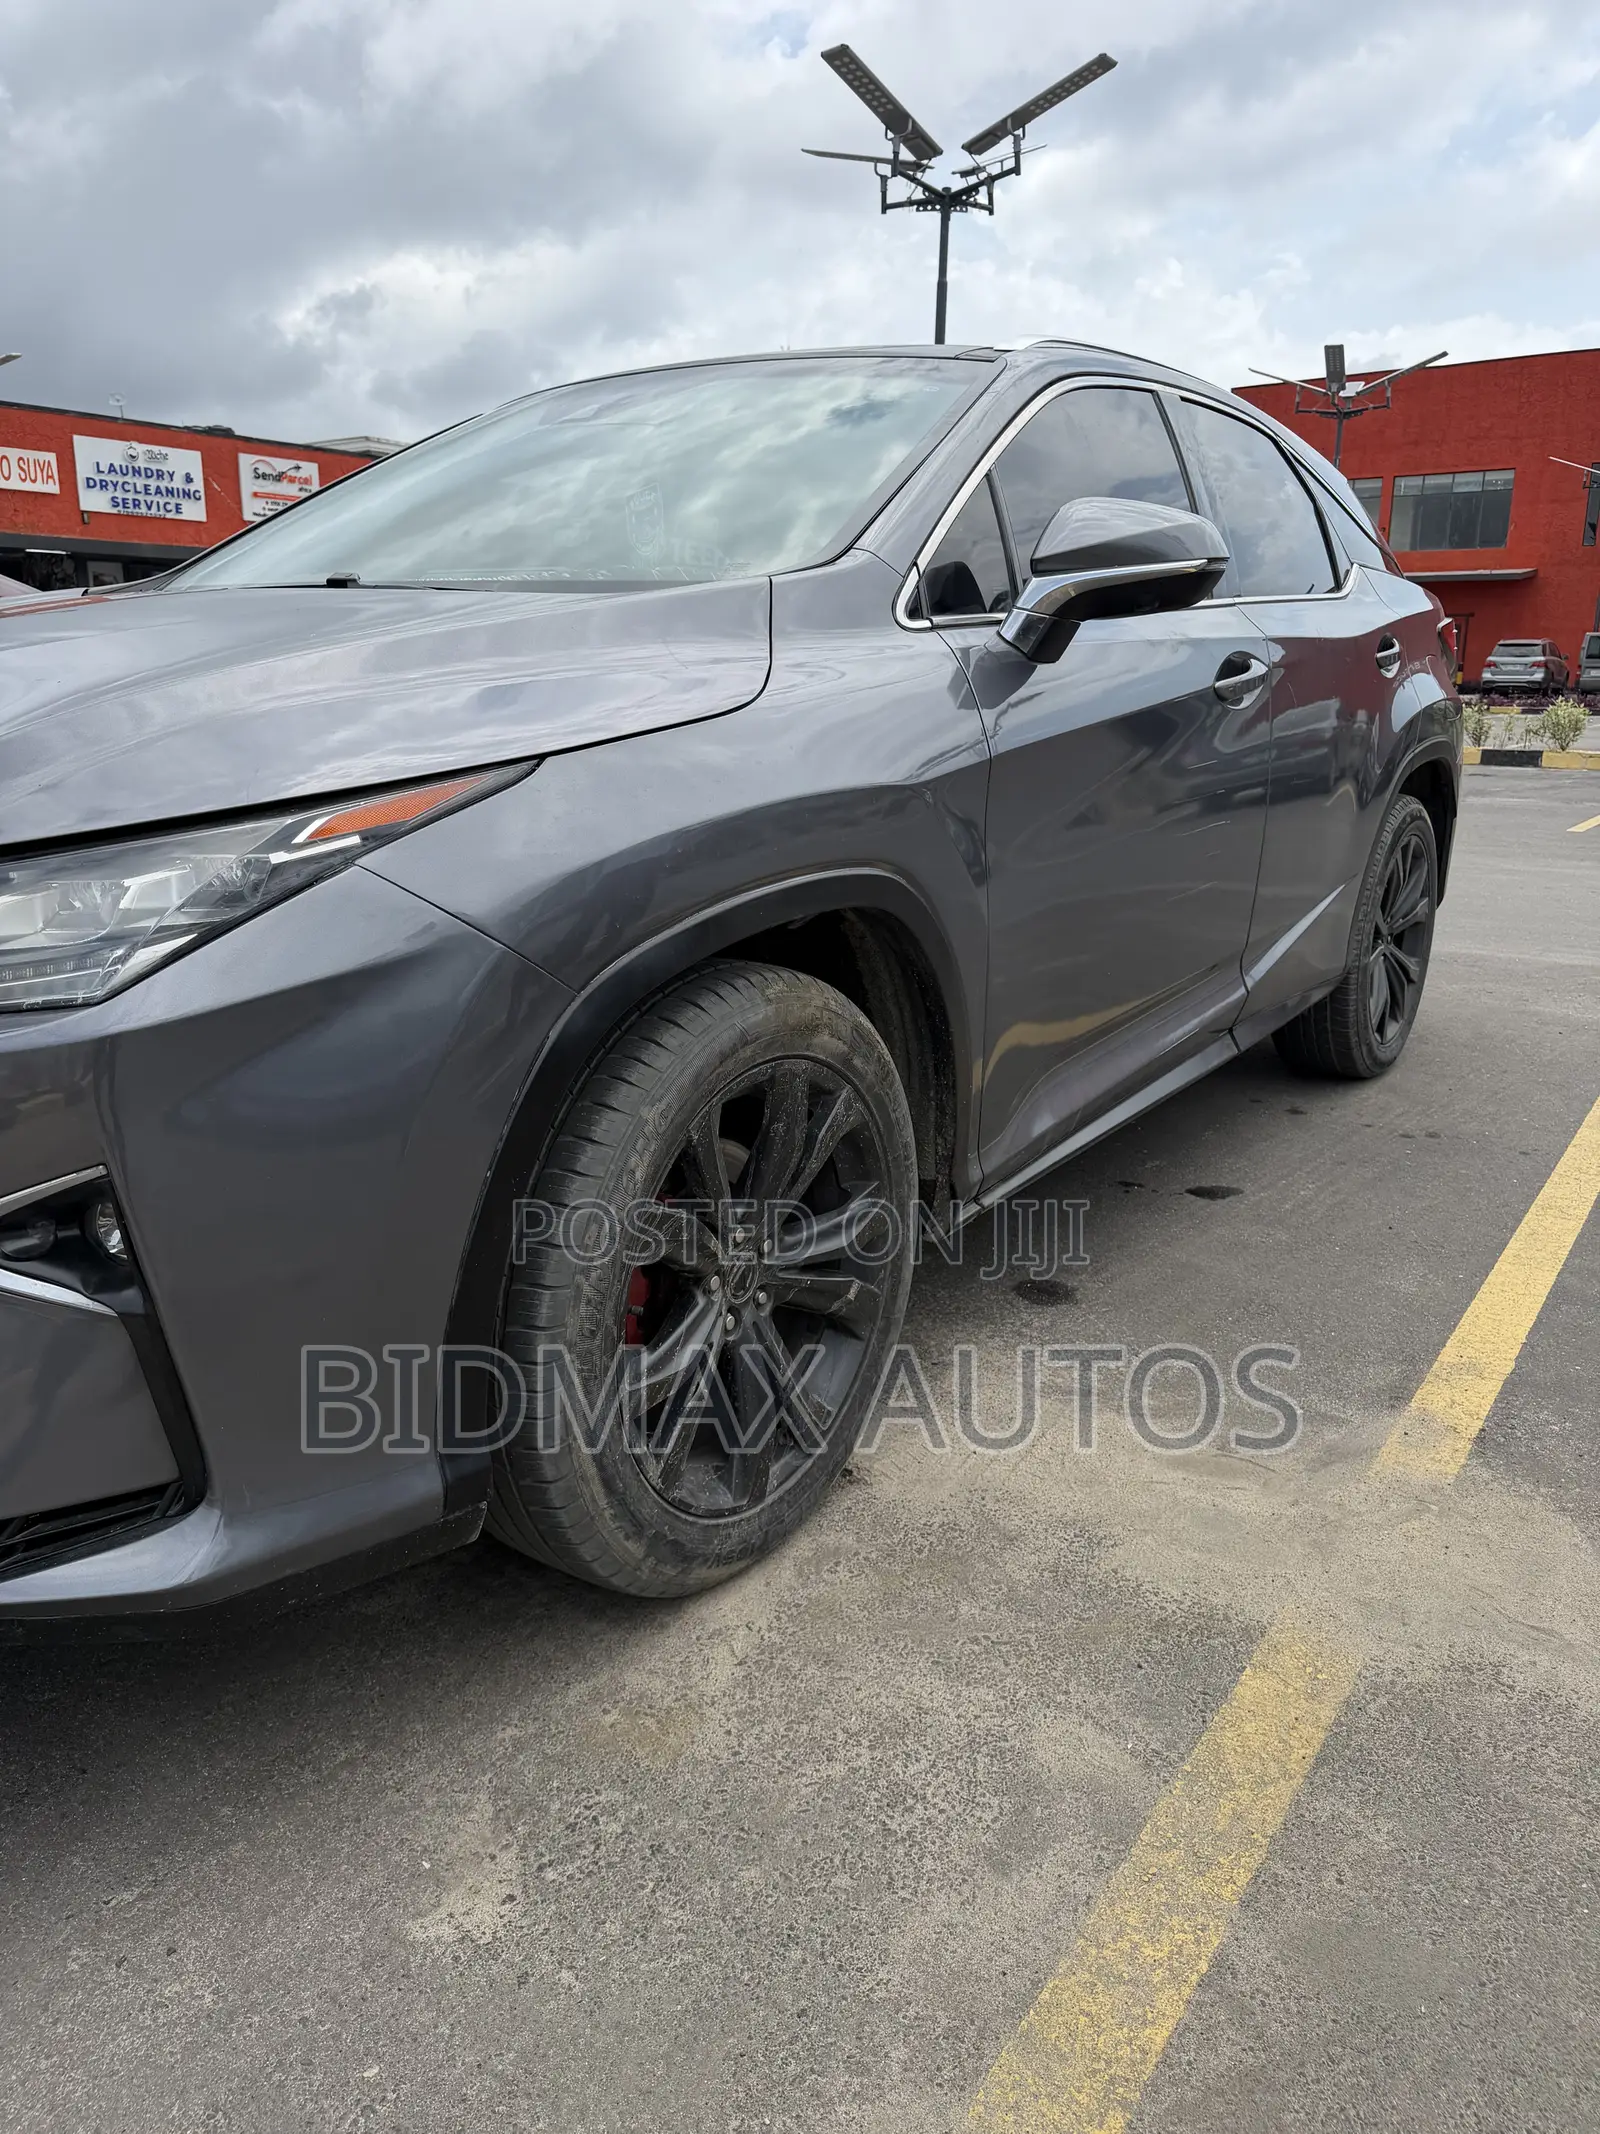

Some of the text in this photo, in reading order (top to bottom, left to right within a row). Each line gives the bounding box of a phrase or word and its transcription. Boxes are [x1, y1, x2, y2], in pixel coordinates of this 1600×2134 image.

[18, 457, 56, 486] SUYA
[96, 461, 194, 484] LAUNDRY &
[253, 467, 313, 486] SendParcel
[85, 477, 202, 501] DRYCLEANING
[111, 496, 183, 514] SERVICE
